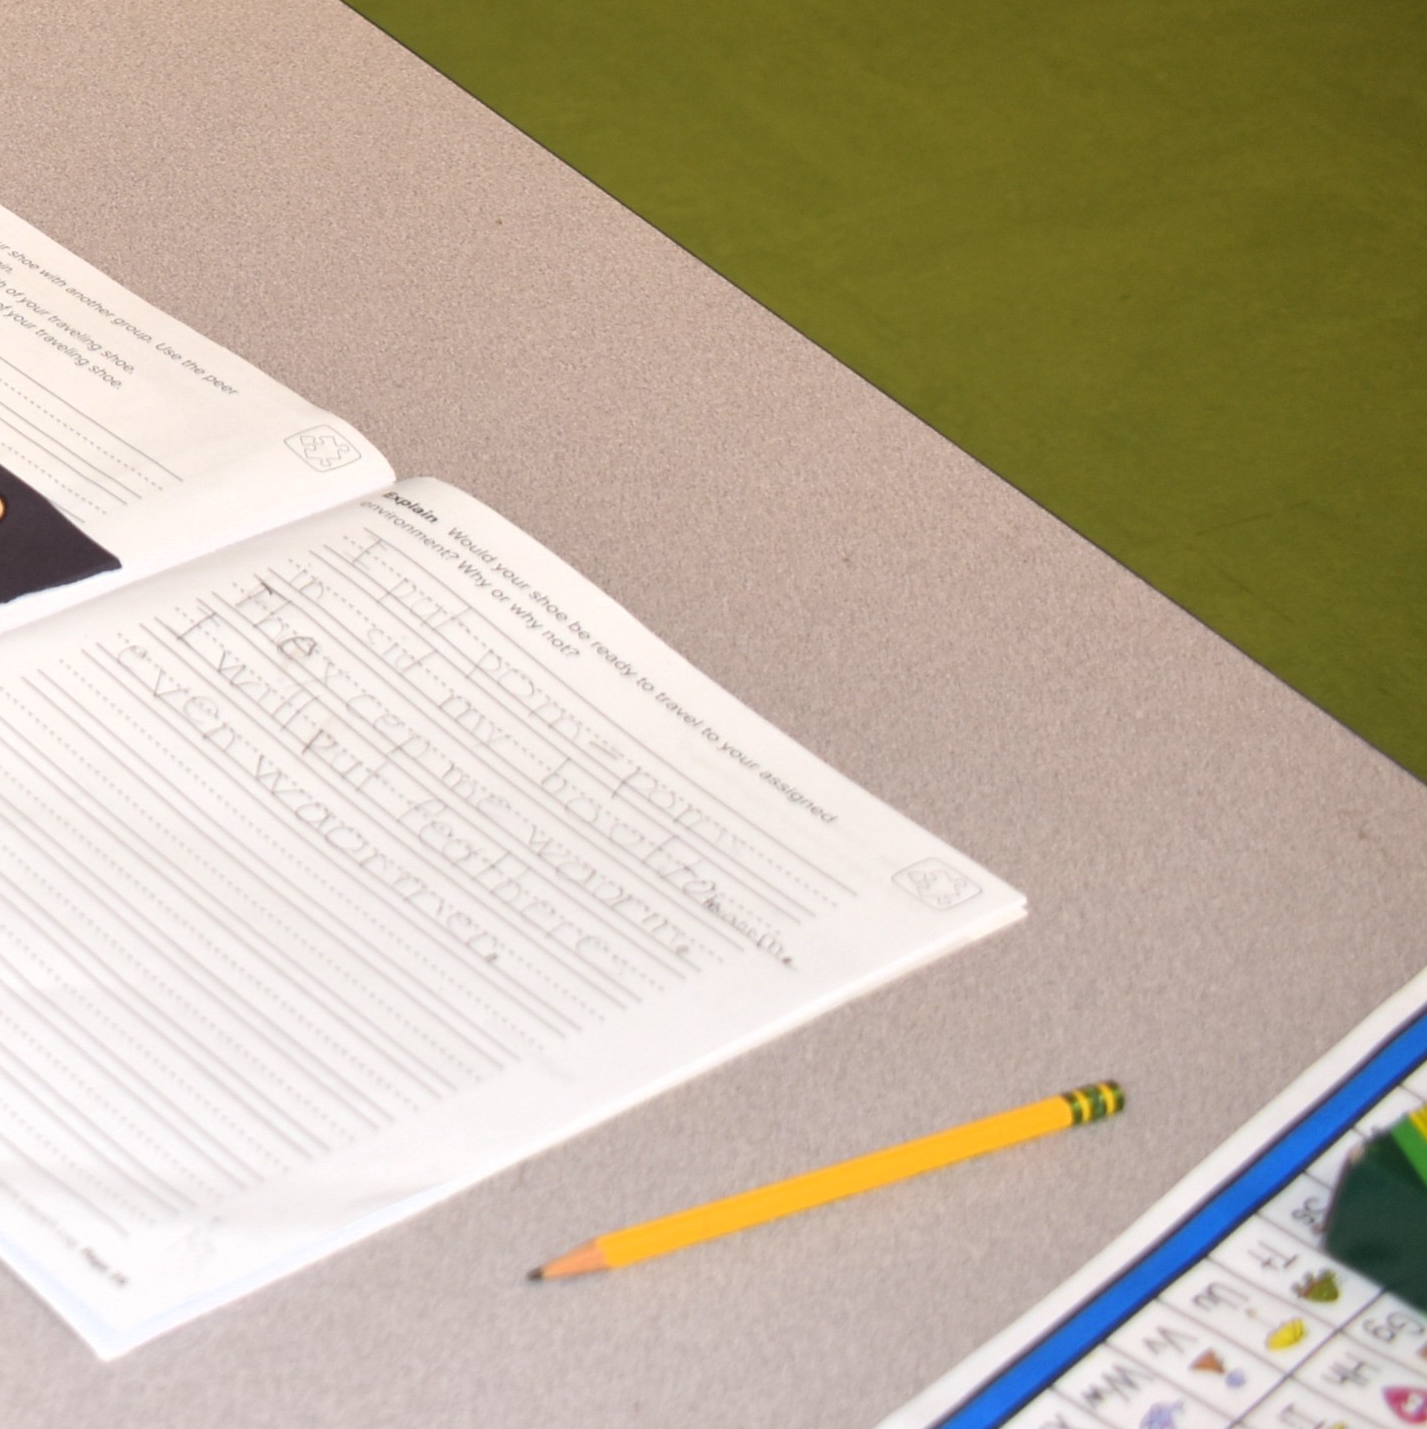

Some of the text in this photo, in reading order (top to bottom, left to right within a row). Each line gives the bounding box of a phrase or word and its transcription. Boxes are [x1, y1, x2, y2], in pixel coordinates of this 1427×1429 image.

[2, 310, 38, 330] your
[34, 328, 91, 367] traveling
[87, 365, 123, 390] shoe.
[4, 288, 25, 298] of
[15, 296, 51, 316] your
[47, 315, 103, 352] traveling
[100, 350, 135, 375] shoe.
[7, 250, 40, 270] shoe
[38, 269, 67, 288] with
[64, 287, 116, 318] another
[109, 317, 153, 344] group.
[154, 342, 183, 361] Use
[181, 359, 206, 375] the
[201, 374, 239, 395] peer
[357, 499, 581, 657] environment? Why or why not?
[381, 491, 839, 824] Explain Would your shoe be ready to travel to your assigned
